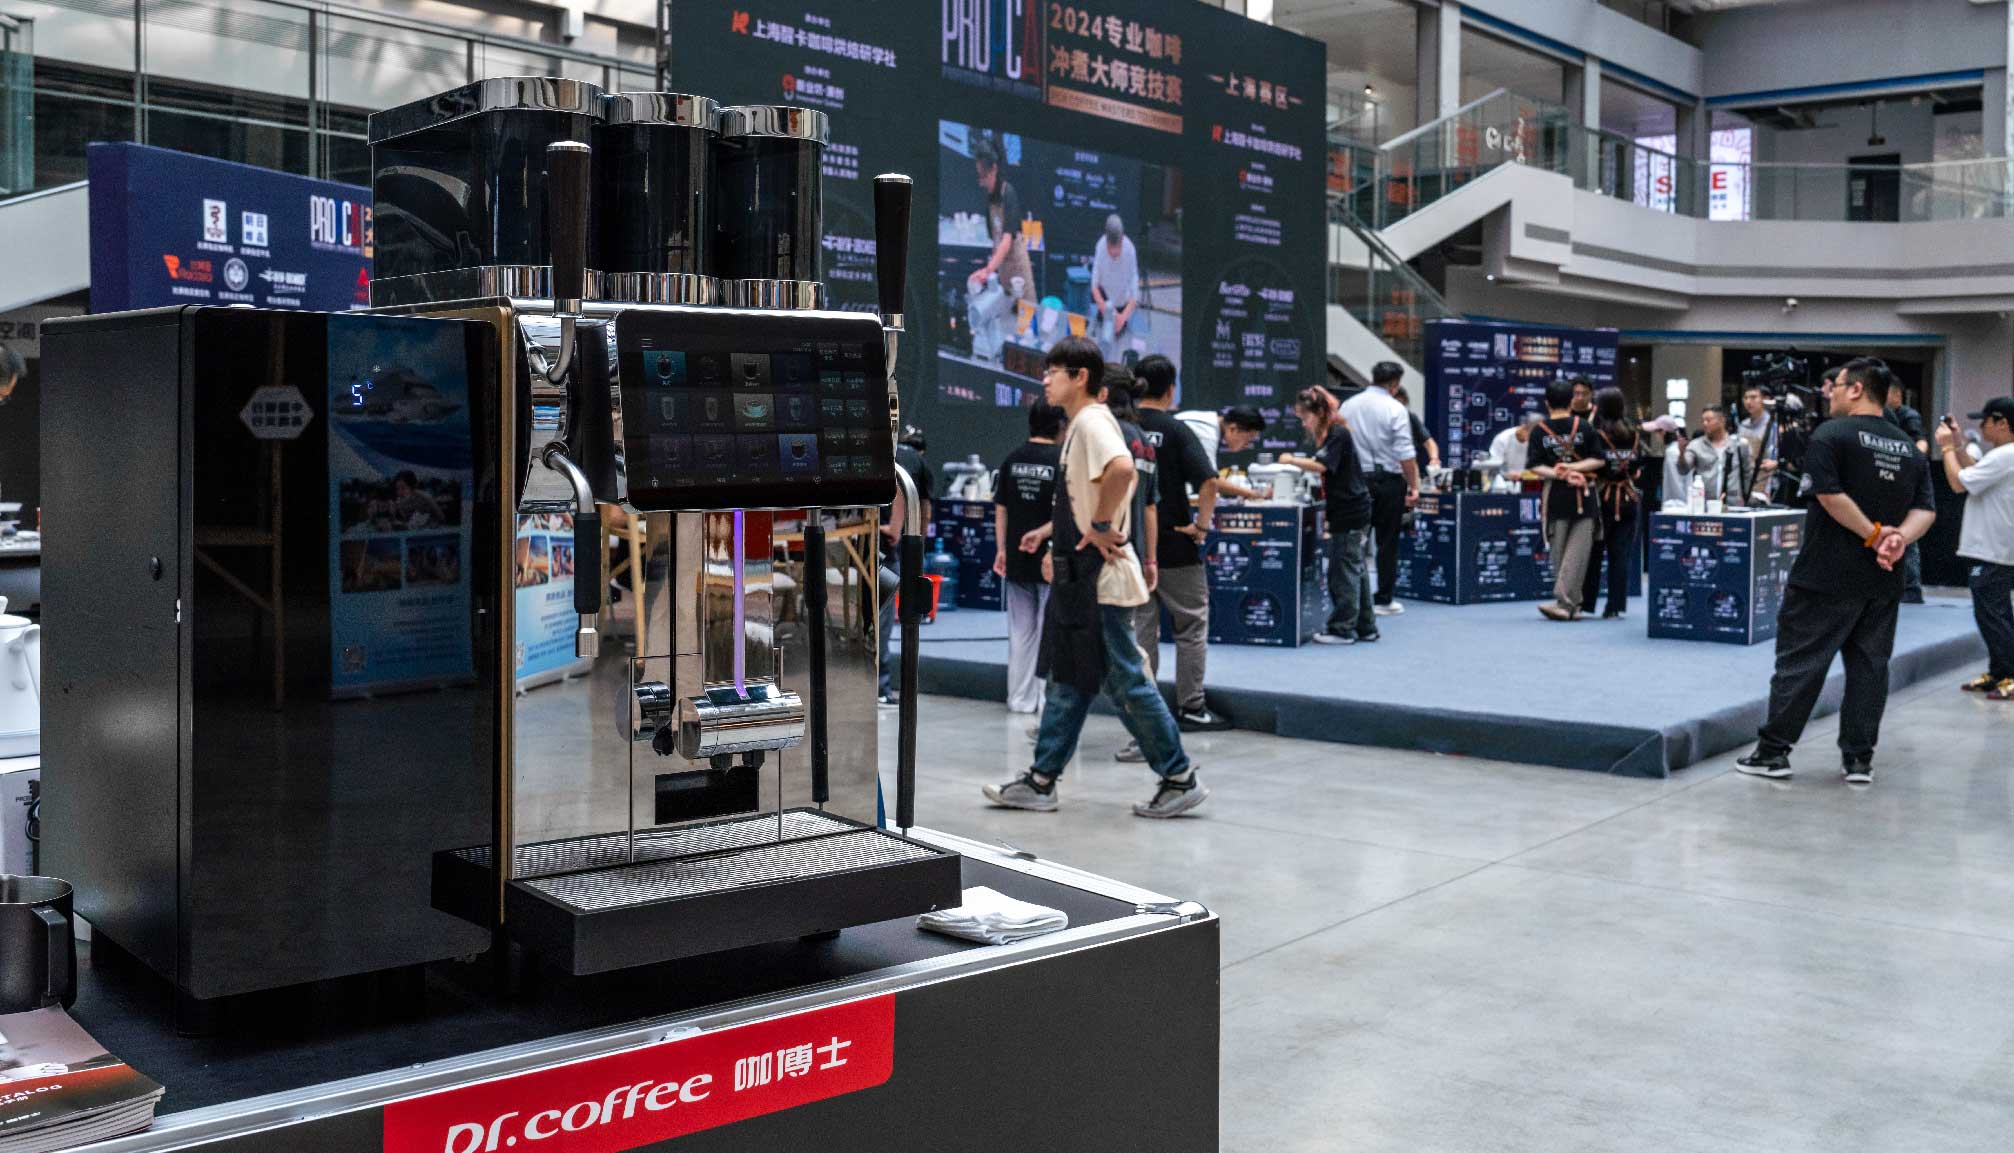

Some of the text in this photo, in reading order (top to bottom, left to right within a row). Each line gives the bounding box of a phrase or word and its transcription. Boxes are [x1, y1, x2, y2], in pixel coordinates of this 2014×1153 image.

[1050, 2, 1182, 65] 2024专业咖啡
[1050, 44, 1182, 105] 冲煮大师竞技赛
[1655, 176, 1673, 194] S
[1711, 171, 1728, 191] E
[1863, 434, 1909, 454] BARISTA
[733, 1036, 853, 1092] 咖博士
